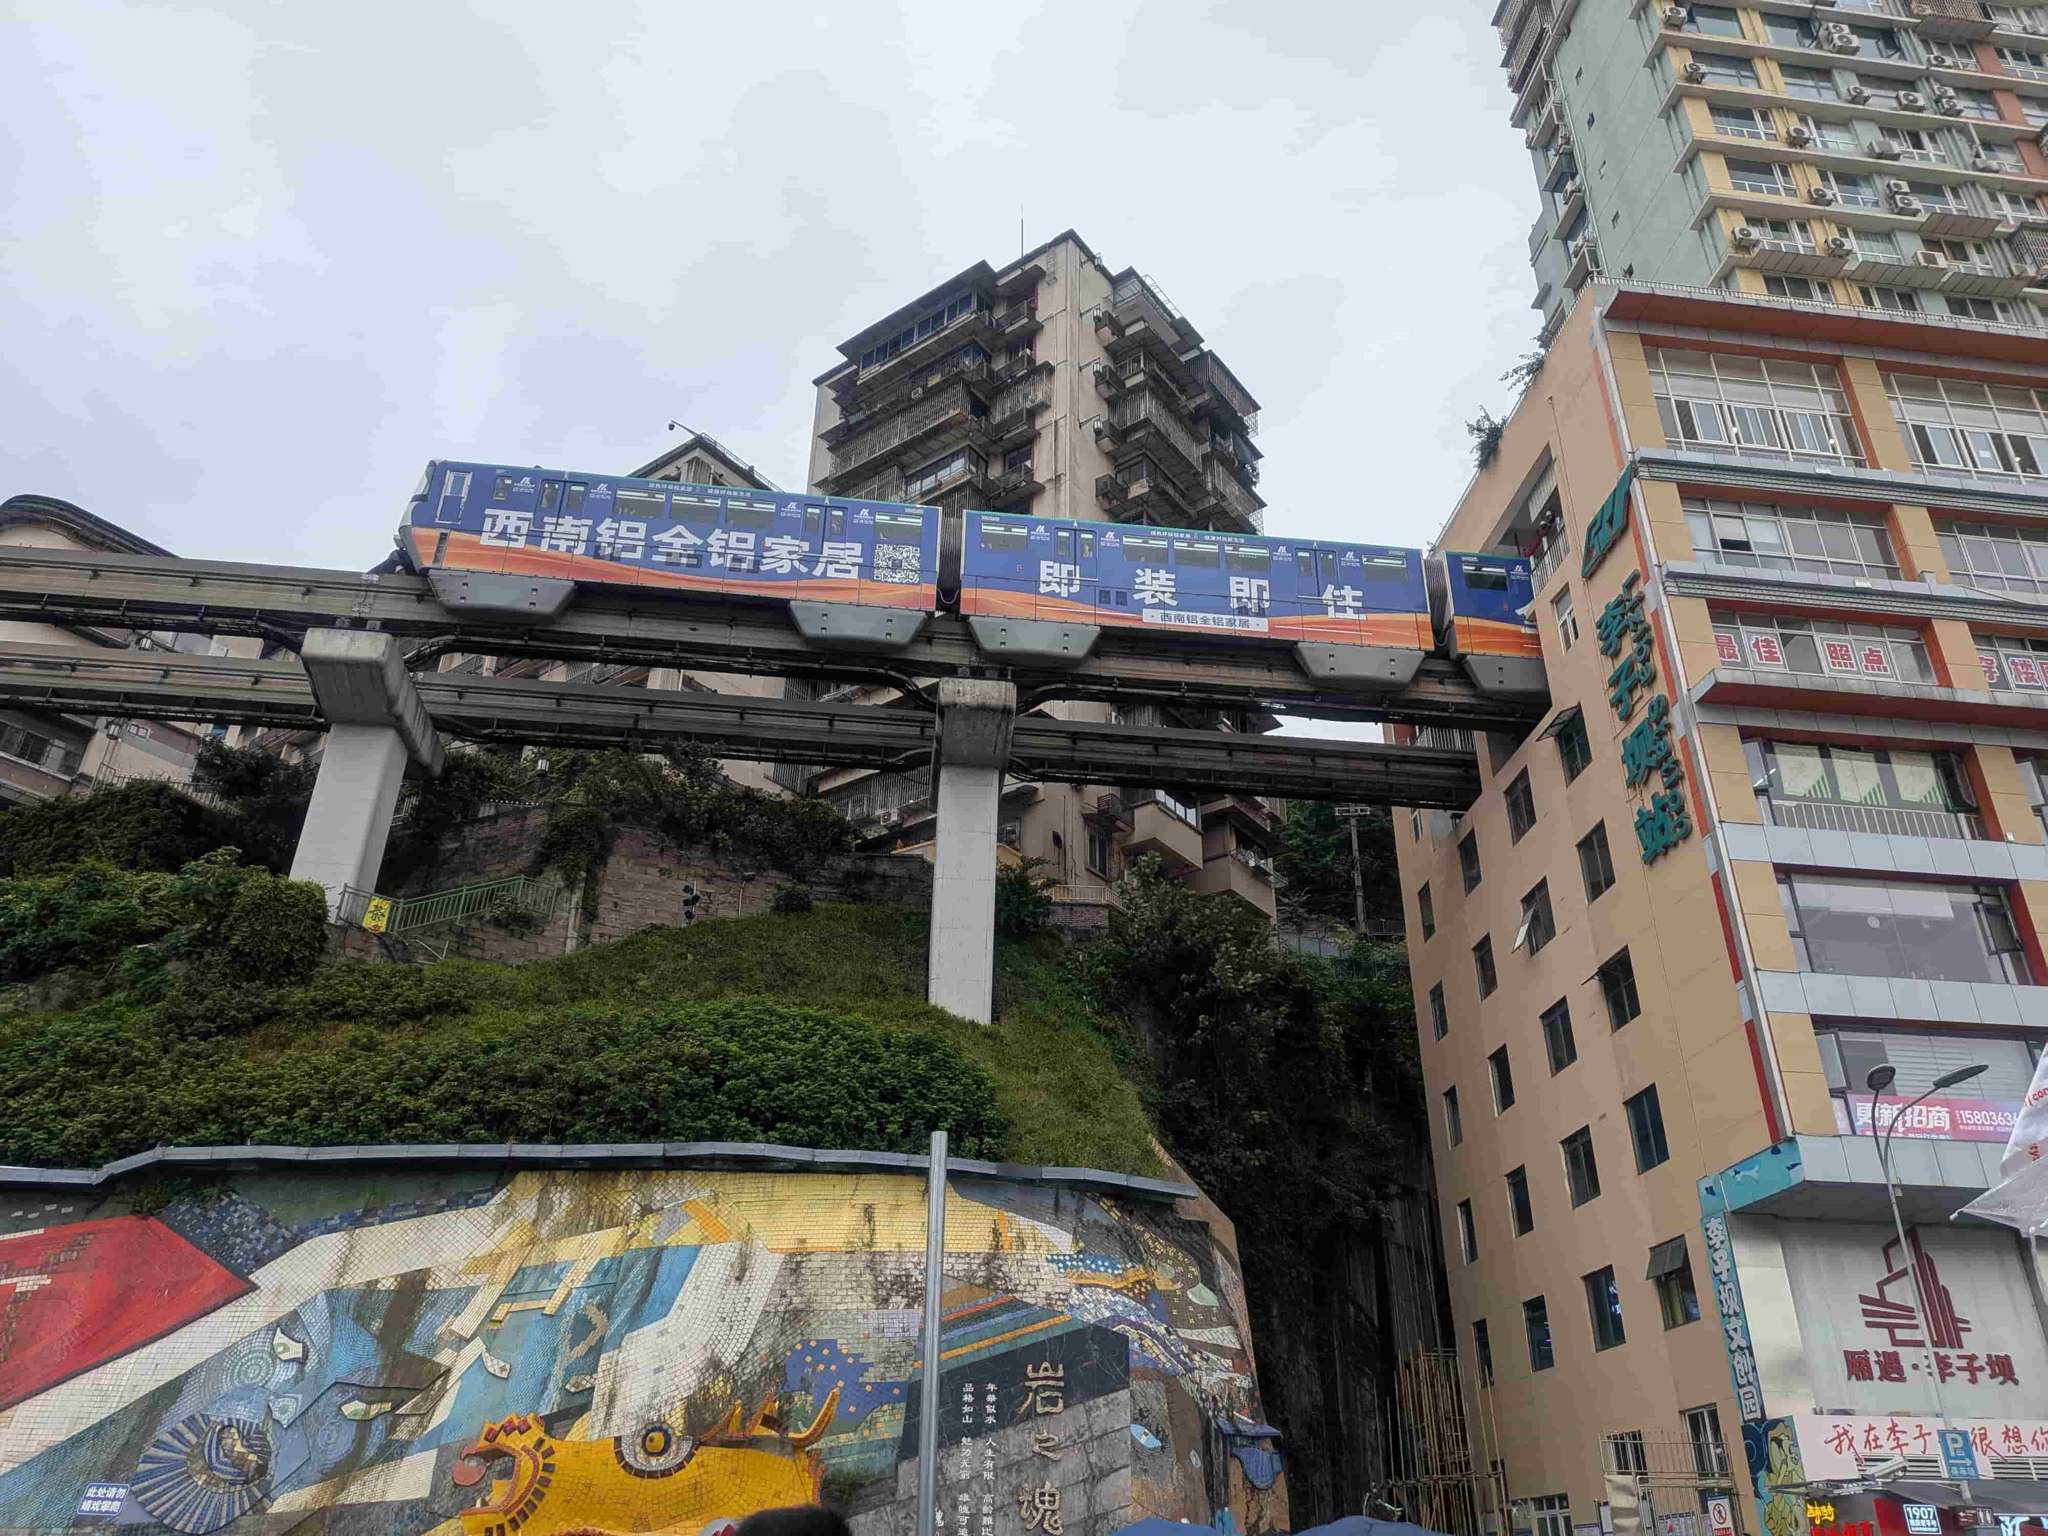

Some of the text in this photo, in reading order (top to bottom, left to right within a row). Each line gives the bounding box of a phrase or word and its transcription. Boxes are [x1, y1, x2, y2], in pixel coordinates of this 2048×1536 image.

[482, 508, 864, 580] 西南铝全铝家居
[1038, 559, 1366, 621] 即装即住
[1160, 612, 1250, 629] 西南铝全铝家居
[1706, 1217, 1762, 1422] 李子坝文创园
[1824, 1417, 2048, 1465] 我在李子很想你
[1906, 1507, 1934, 1519] 1907
